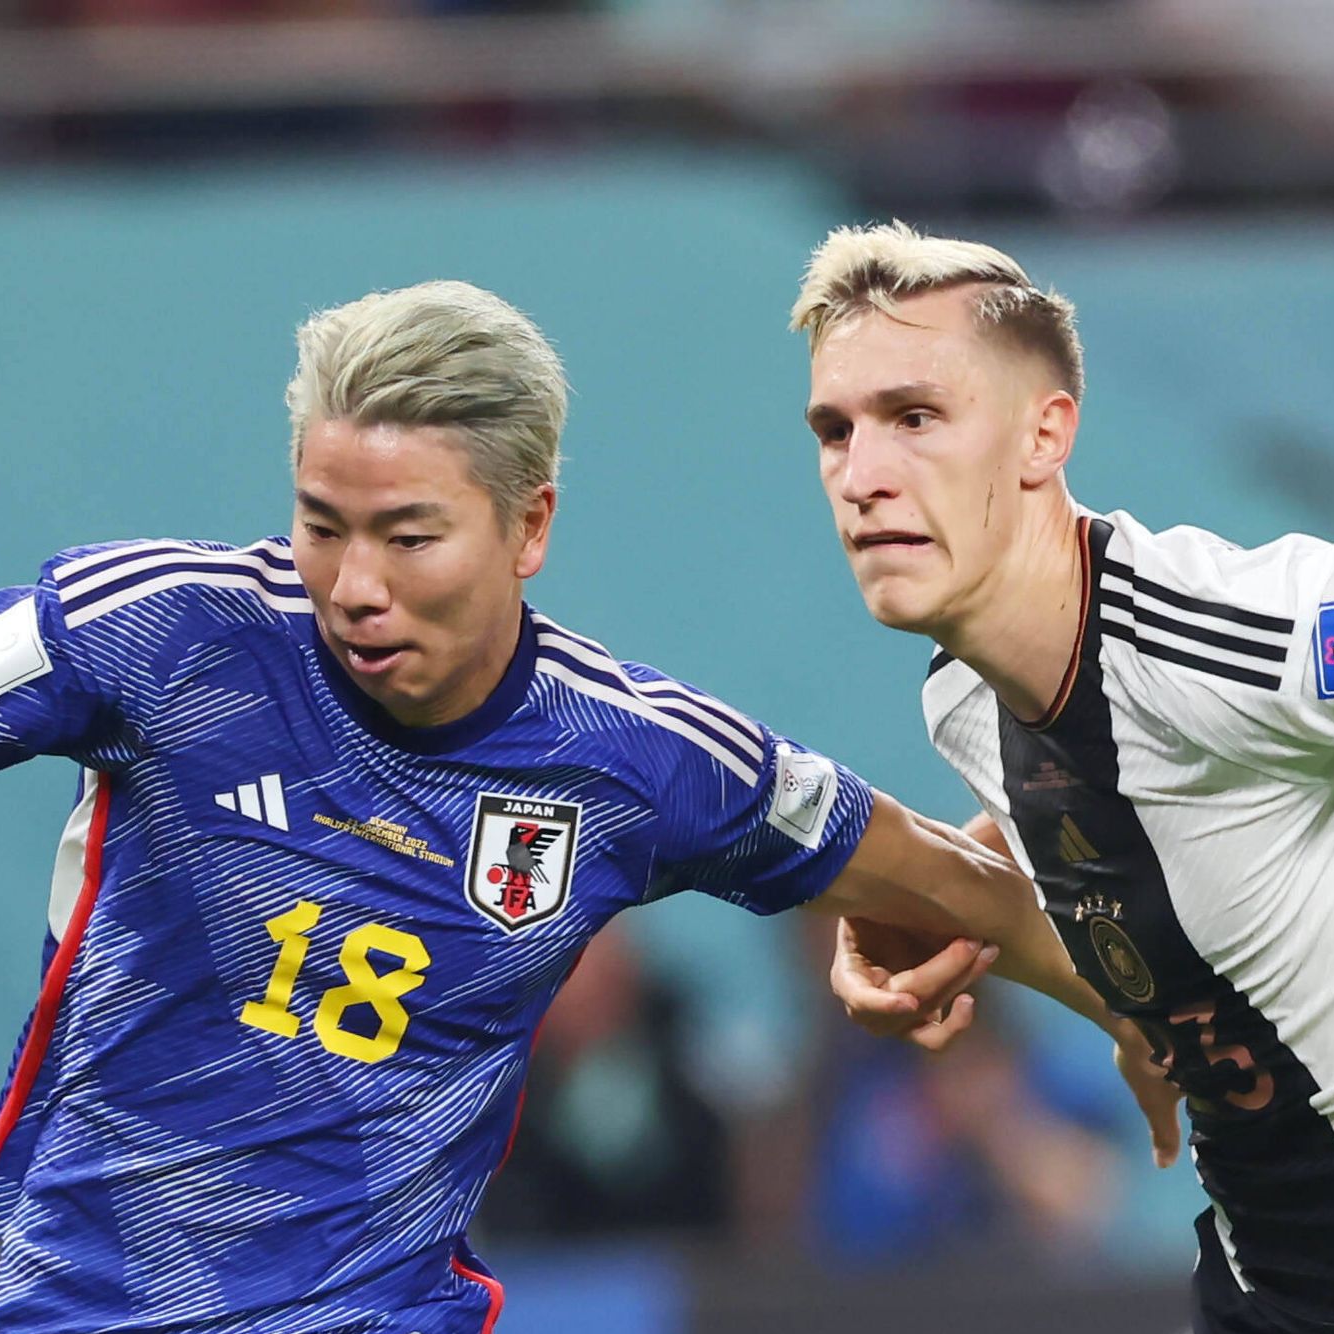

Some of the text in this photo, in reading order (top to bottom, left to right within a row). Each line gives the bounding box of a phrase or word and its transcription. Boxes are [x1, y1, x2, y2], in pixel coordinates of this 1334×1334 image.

[503, 802, 555, 817] JAPAN
[405, 832, 428, 850] 2022
[418, 850, 454, 868] STADIUM
[494, 886, 536, 910] JFA
[240, 900, 432, 1064] 18
